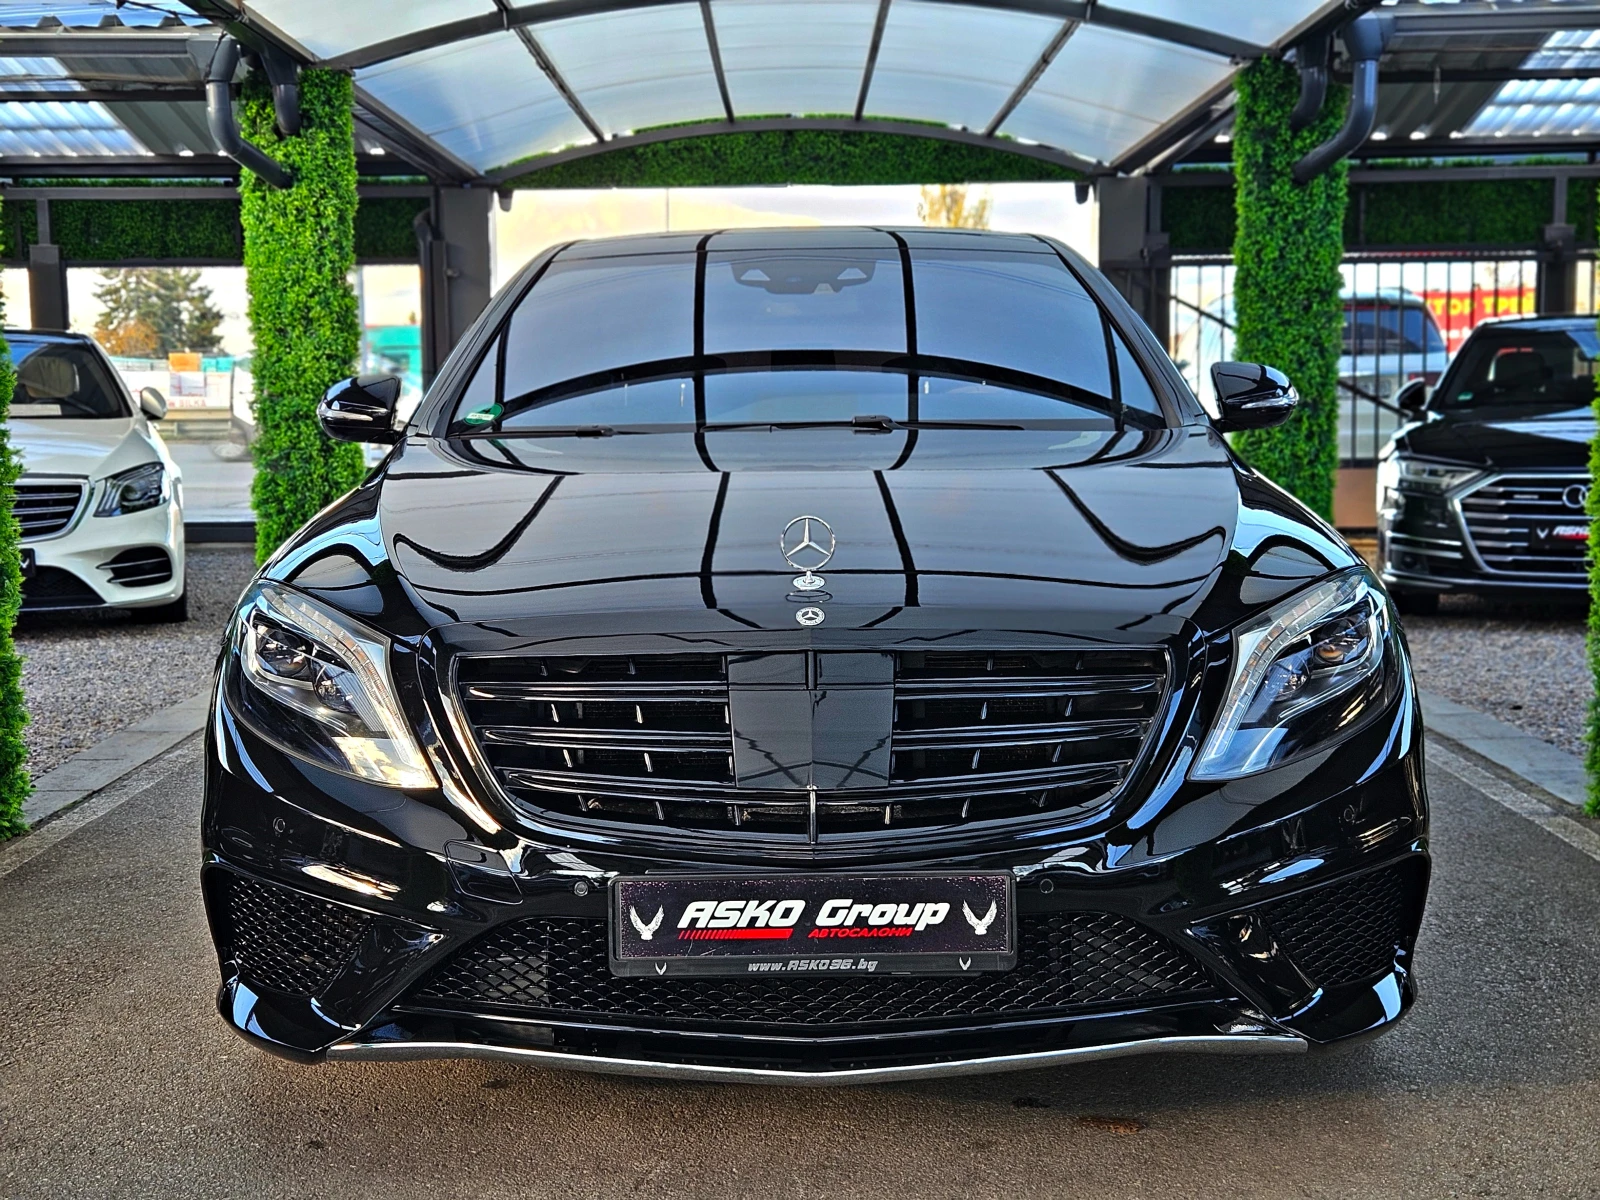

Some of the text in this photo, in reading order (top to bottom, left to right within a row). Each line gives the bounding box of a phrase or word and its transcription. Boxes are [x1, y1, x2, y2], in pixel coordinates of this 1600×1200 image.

[677, 899, 950, 931] ASKO Group
[808, 928, 914, 938] АВТОСАЛОНИ
